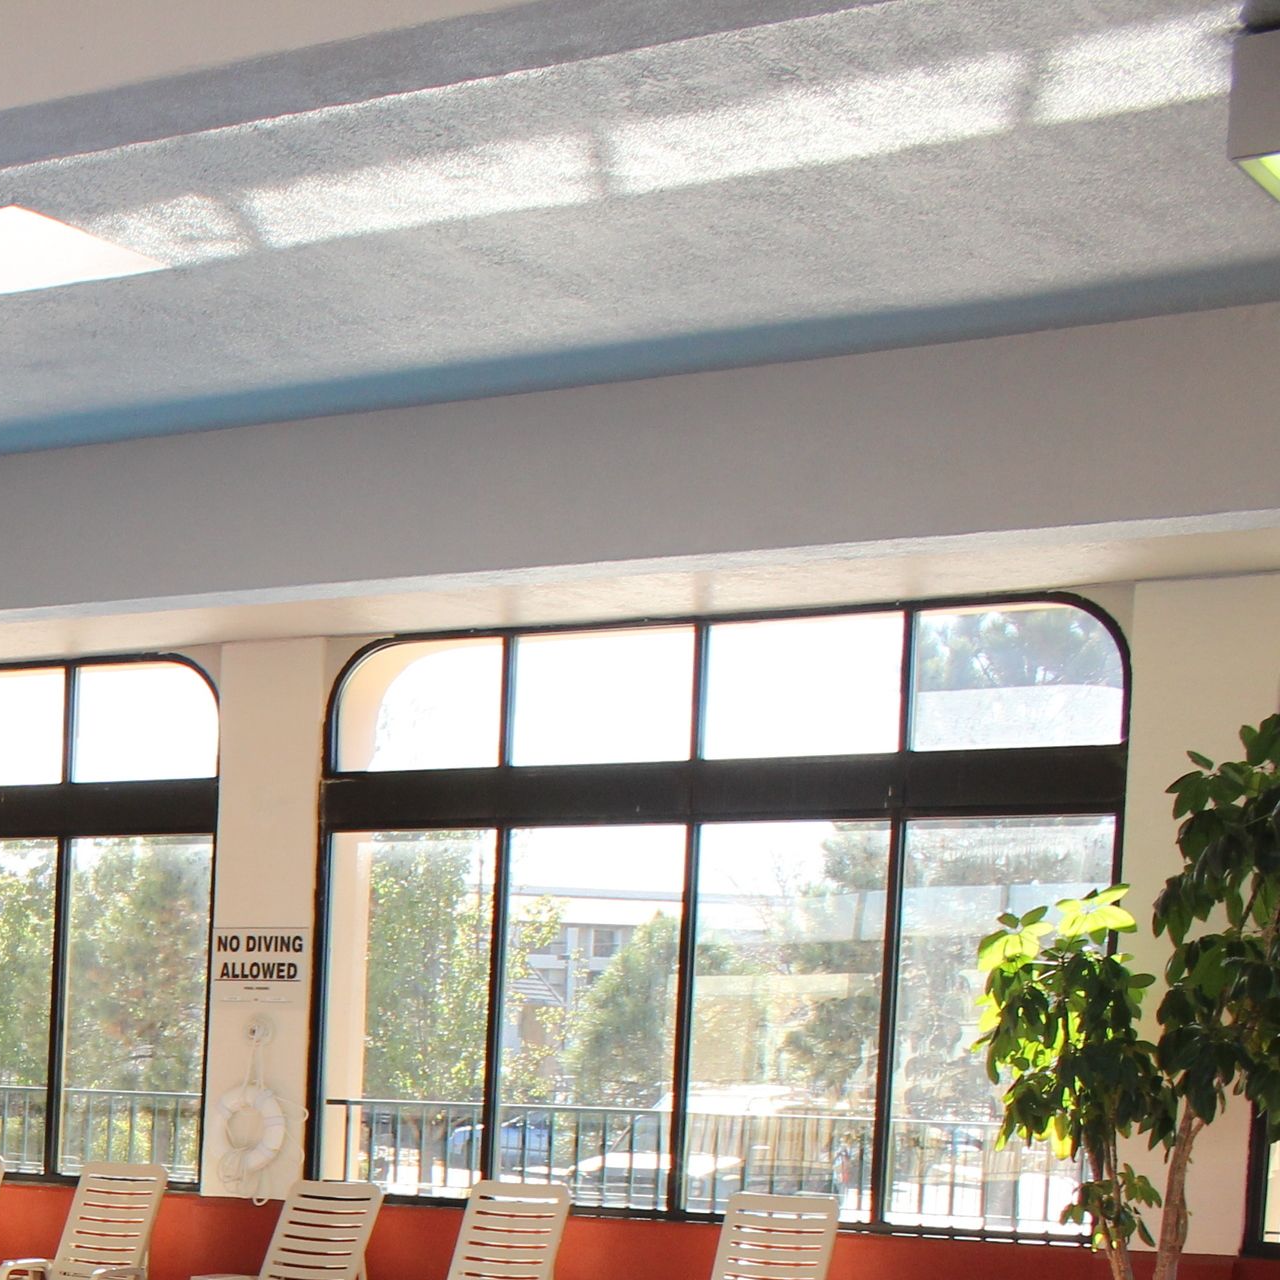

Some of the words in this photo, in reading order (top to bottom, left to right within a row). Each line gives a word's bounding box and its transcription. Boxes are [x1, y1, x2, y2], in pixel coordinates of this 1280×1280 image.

[217, 935, 240, 953] NO
[246, 935, 303, 953] DIVING
[220, 962, 298, 979] ALLOWED
